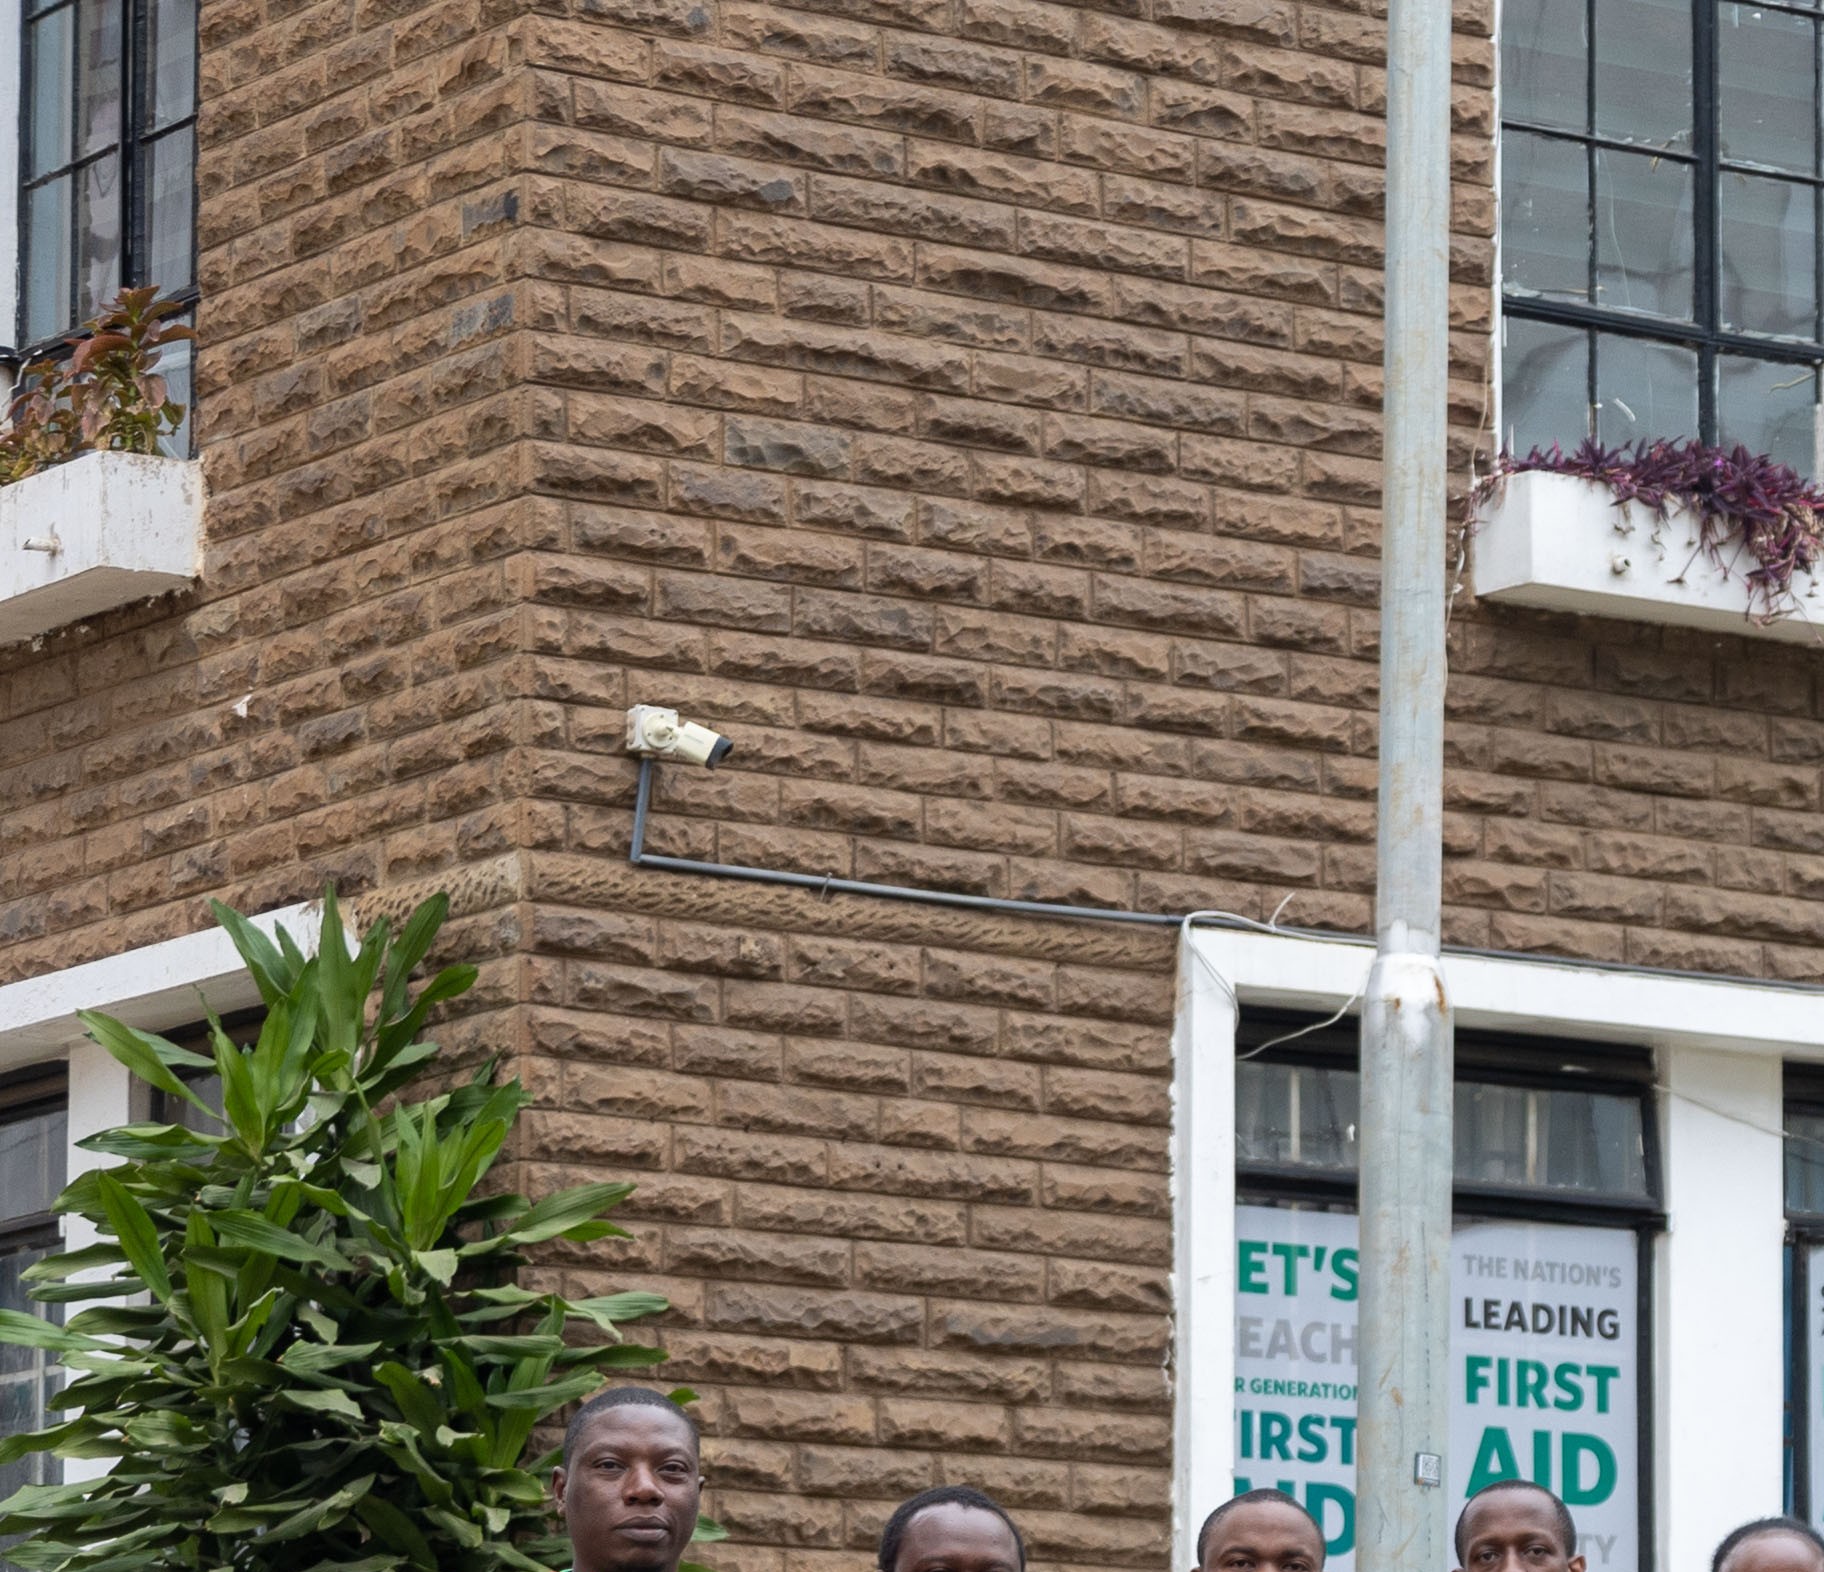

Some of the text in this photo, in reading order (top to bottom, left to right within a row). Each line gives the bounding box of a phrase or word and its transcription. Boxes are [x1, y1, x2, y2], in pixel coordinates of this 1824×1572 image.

[1238, 1240, 1359, 1302] ET'S
[1463, 1254, 1622, 1289] THE NATION'S
[1235, 1315, 1359, 1365] EACH
[1464, 1297, 1621, 1340] LEADING
[1466, 1354, 1622, 1415] FIRST
[1235, 1409, 1358, 1466] IRST
[1464, 1426, 1618, 1506] AID
